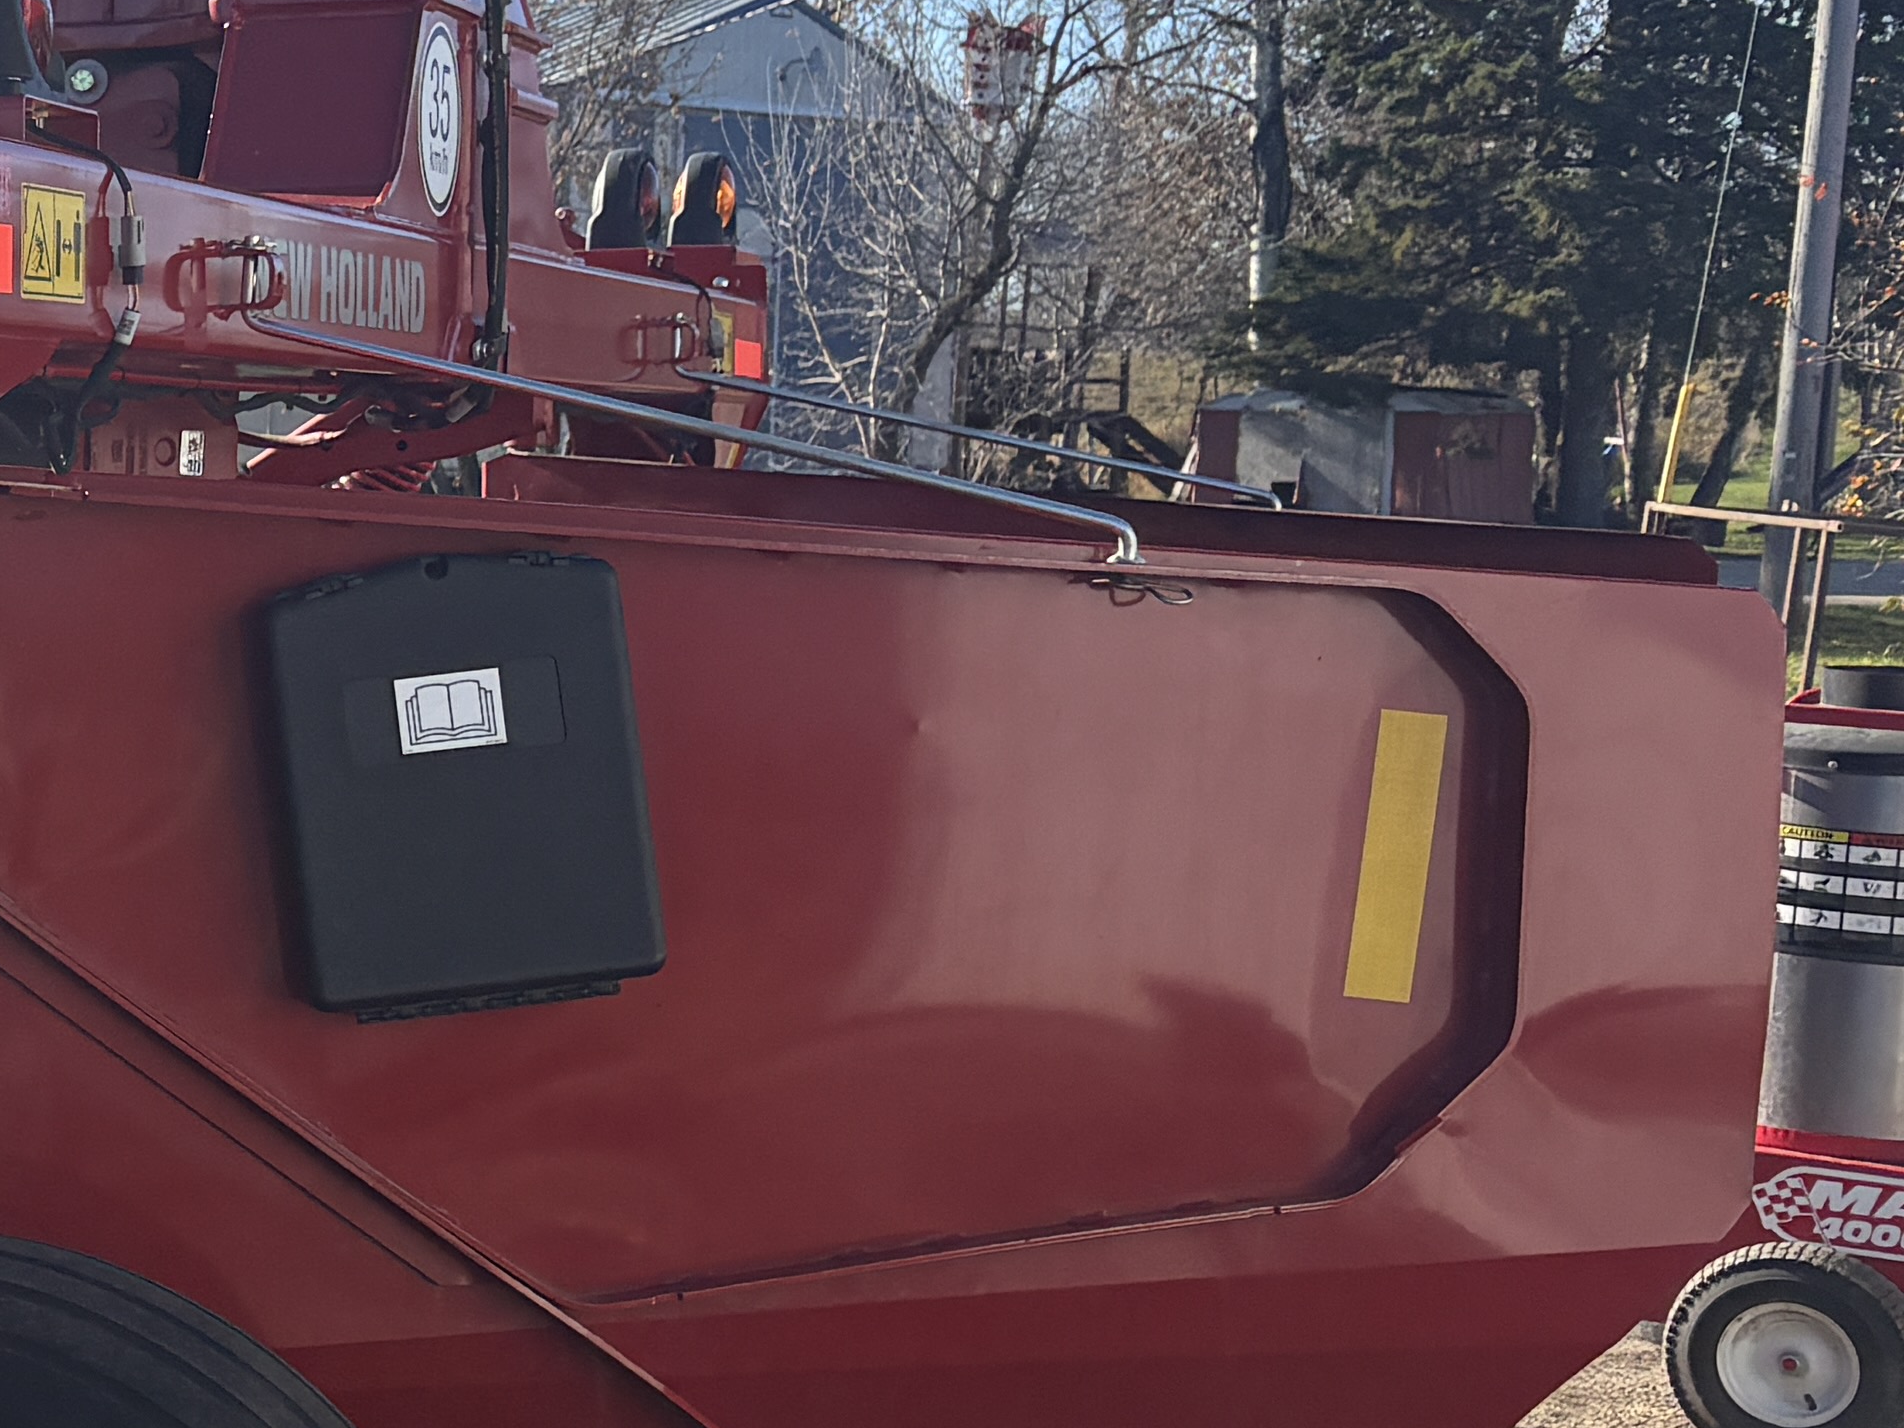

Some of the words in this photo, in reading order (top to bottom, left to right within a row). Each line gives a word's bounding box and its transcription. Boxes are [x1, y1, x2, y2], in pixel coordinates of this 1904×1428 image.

[428, 58, 451, 142] 35
[320, 245, 426, 333] HOLLAND
[1782, 825, 1835, 840] CAUTION
[1812, 1217, 1904, 1250] 400
